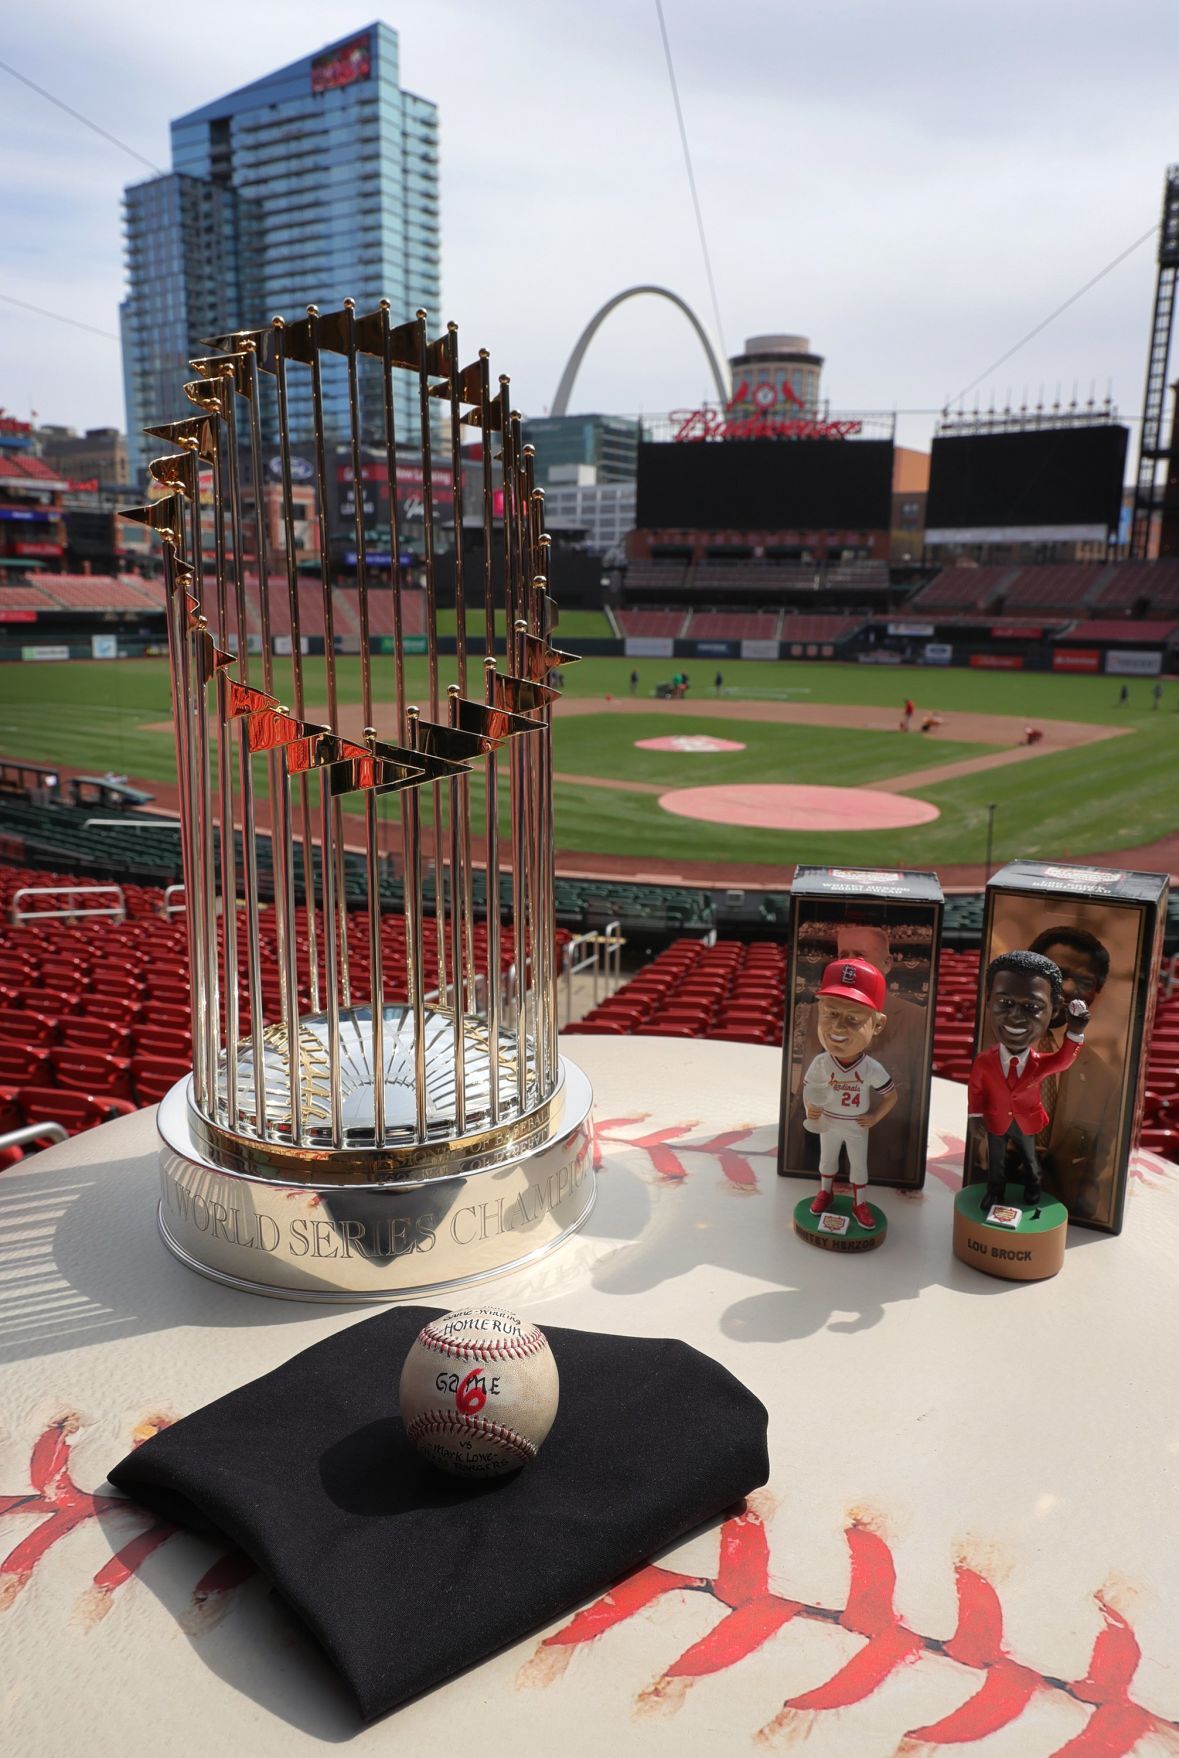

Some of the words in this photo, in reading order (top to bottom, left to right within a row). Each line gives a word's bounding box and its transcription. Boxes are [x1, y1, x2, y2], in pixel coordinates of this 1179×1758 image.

[841, 1092, 861, 1107] 24
[175, 1181, 281, 1252] WORLD
[289, 1213, 437, 1259] SERIES
[967, 1238, 988, 1254] LOU
[991, 1246, 1032, 1261] BROCK
[456, 1367, 487, 1417] 6
